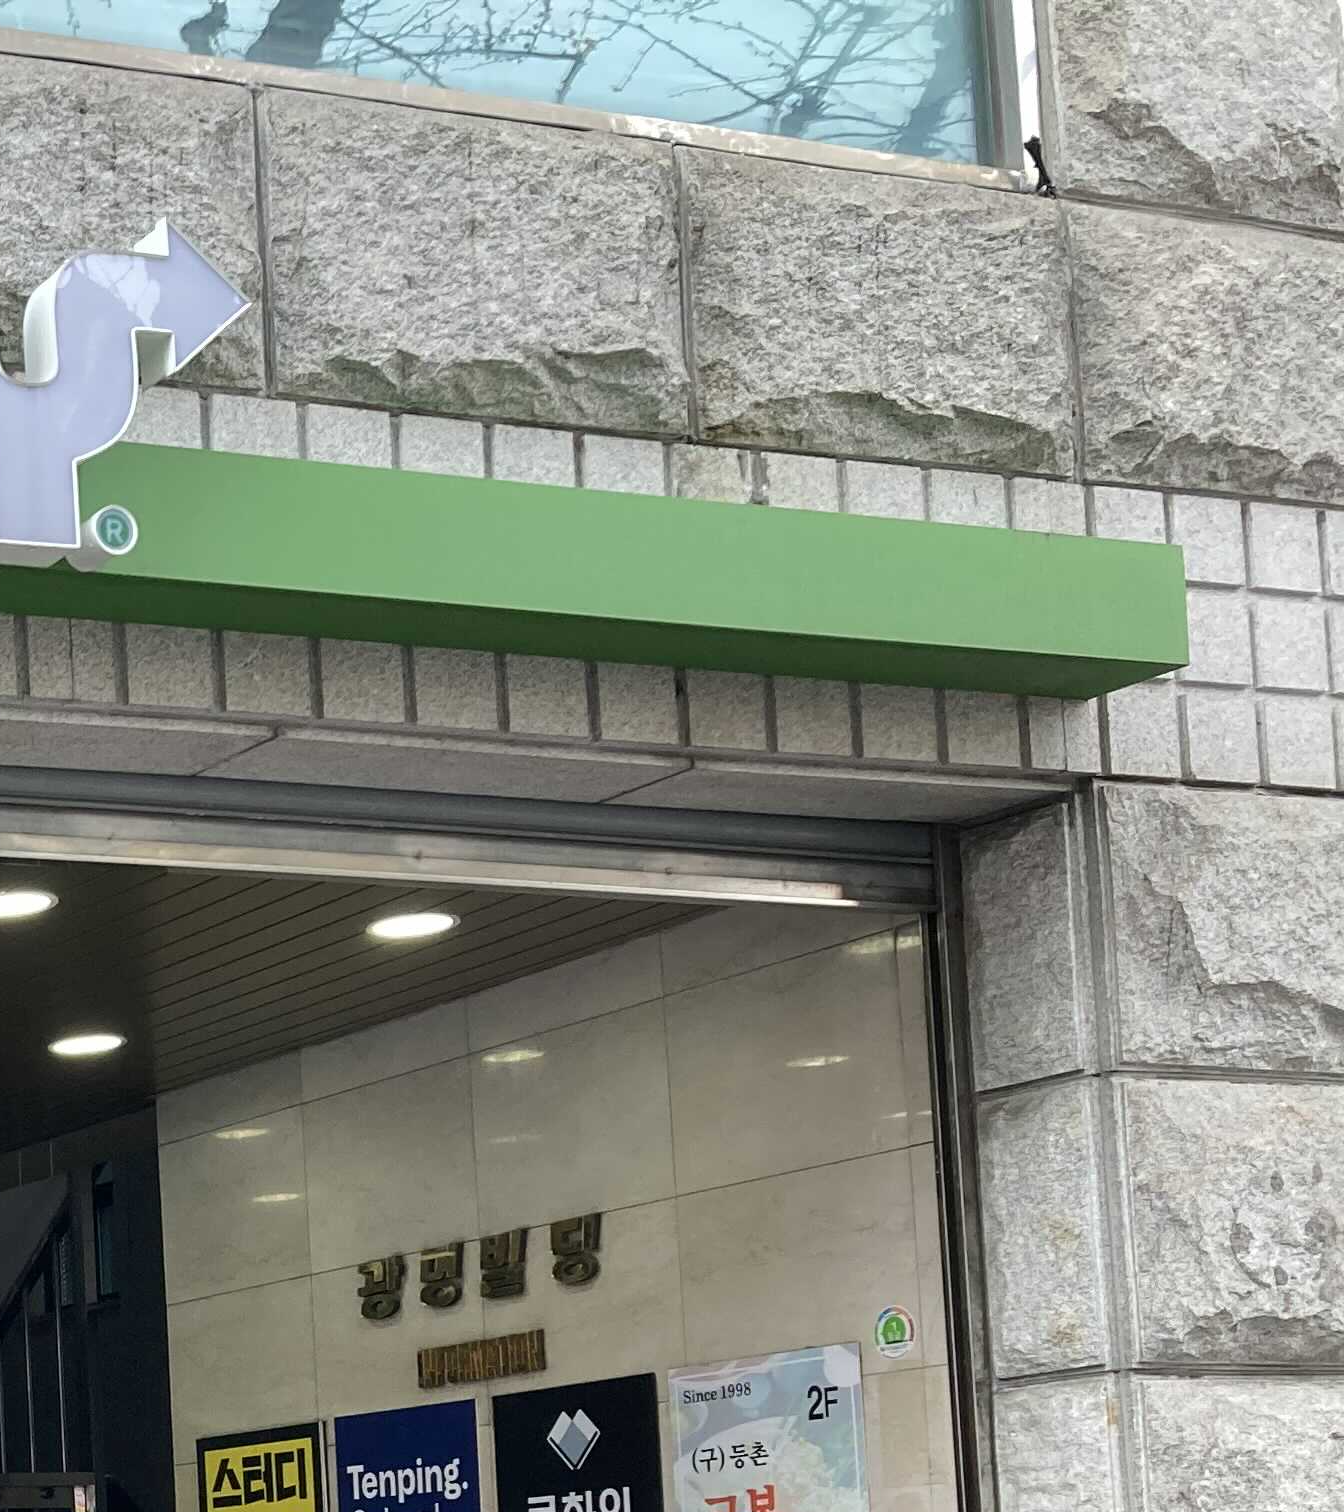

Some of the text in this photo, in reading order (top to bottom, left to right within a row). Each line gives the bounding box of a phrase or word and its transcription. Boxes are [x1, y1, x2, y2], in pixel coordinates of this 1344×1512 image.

[683, 1382, 753, 1405] Since 1998
[808, 1386, 838, 1420] 2F
[691, 1440, 770, 1474] (구) 등촌
[212, 1448, 308, 1509] 스터디
[346, 1457, 469, 1503] Tenping.
